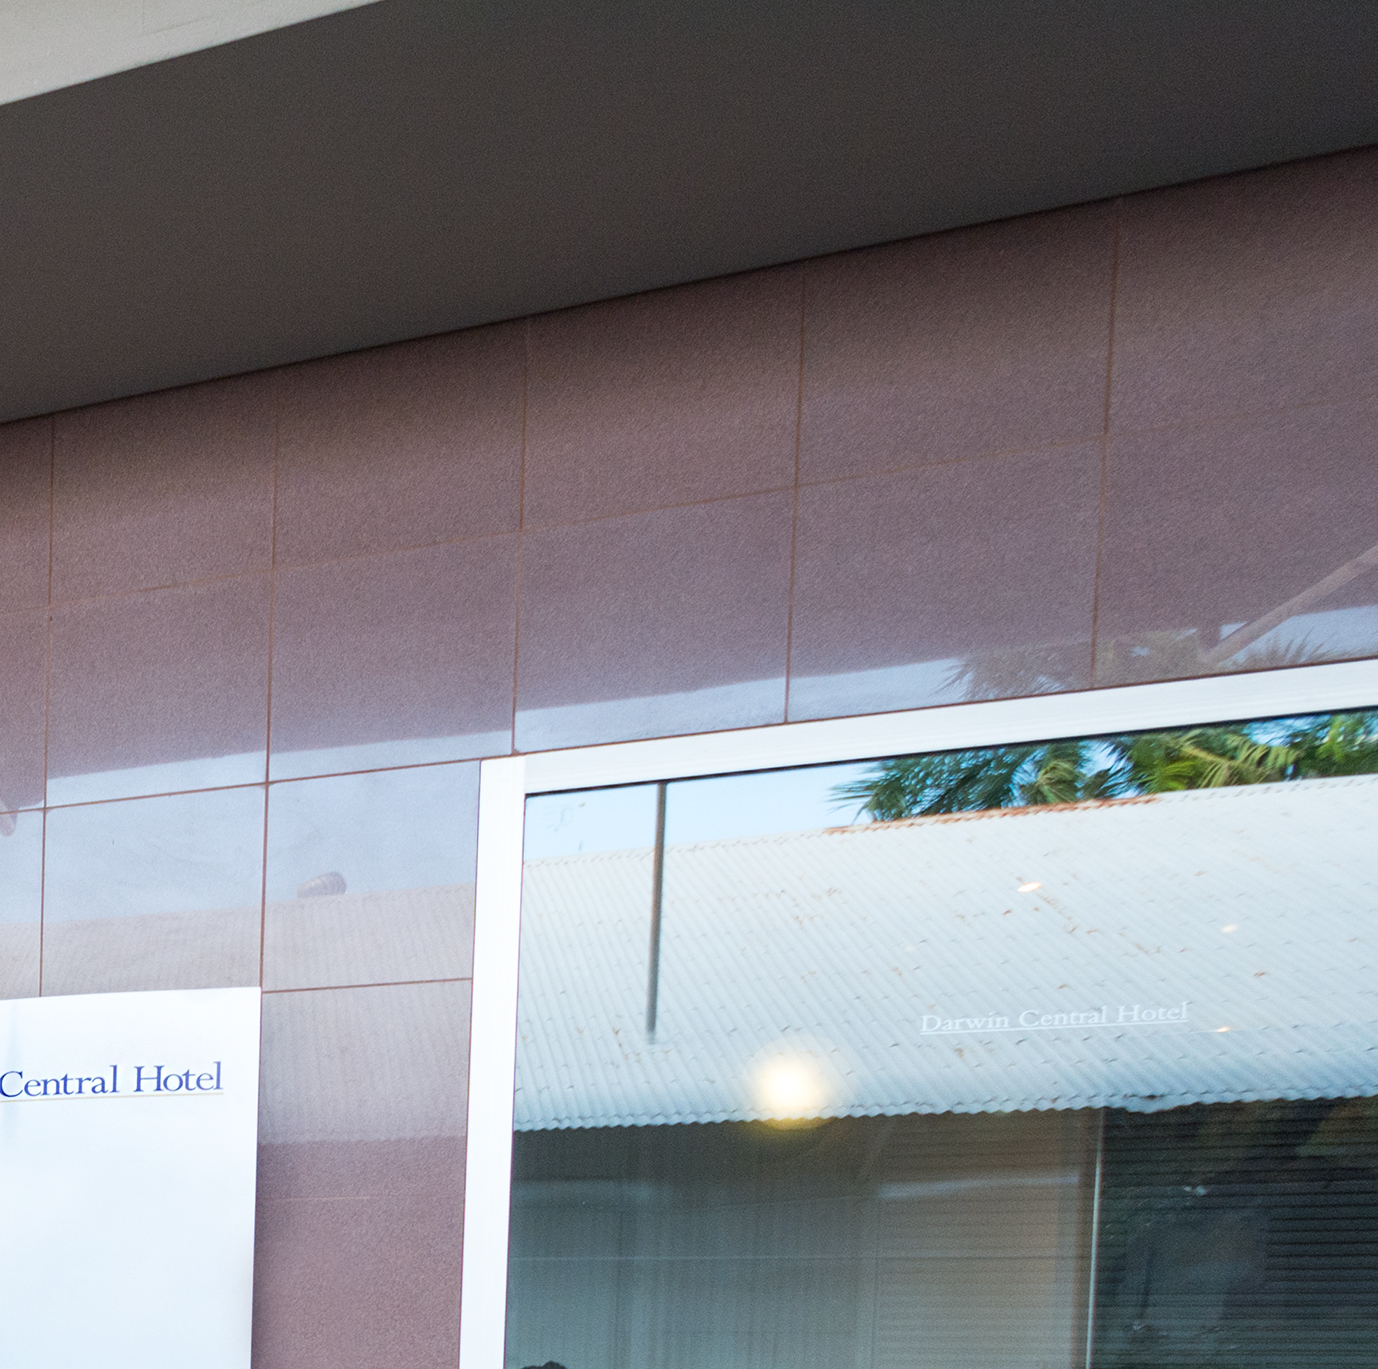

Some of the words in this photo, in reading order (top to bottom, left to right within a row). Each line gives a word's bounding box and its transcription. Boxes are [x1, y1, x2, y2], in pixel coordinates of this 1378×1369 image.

[919, 1010, 1009, 1032] Darwin
[1018, 1005, 1108, 1028] Central
[1116, 1001, 1189, 1024] Hotel
[133, 1060, 225, 1094] Hotel
